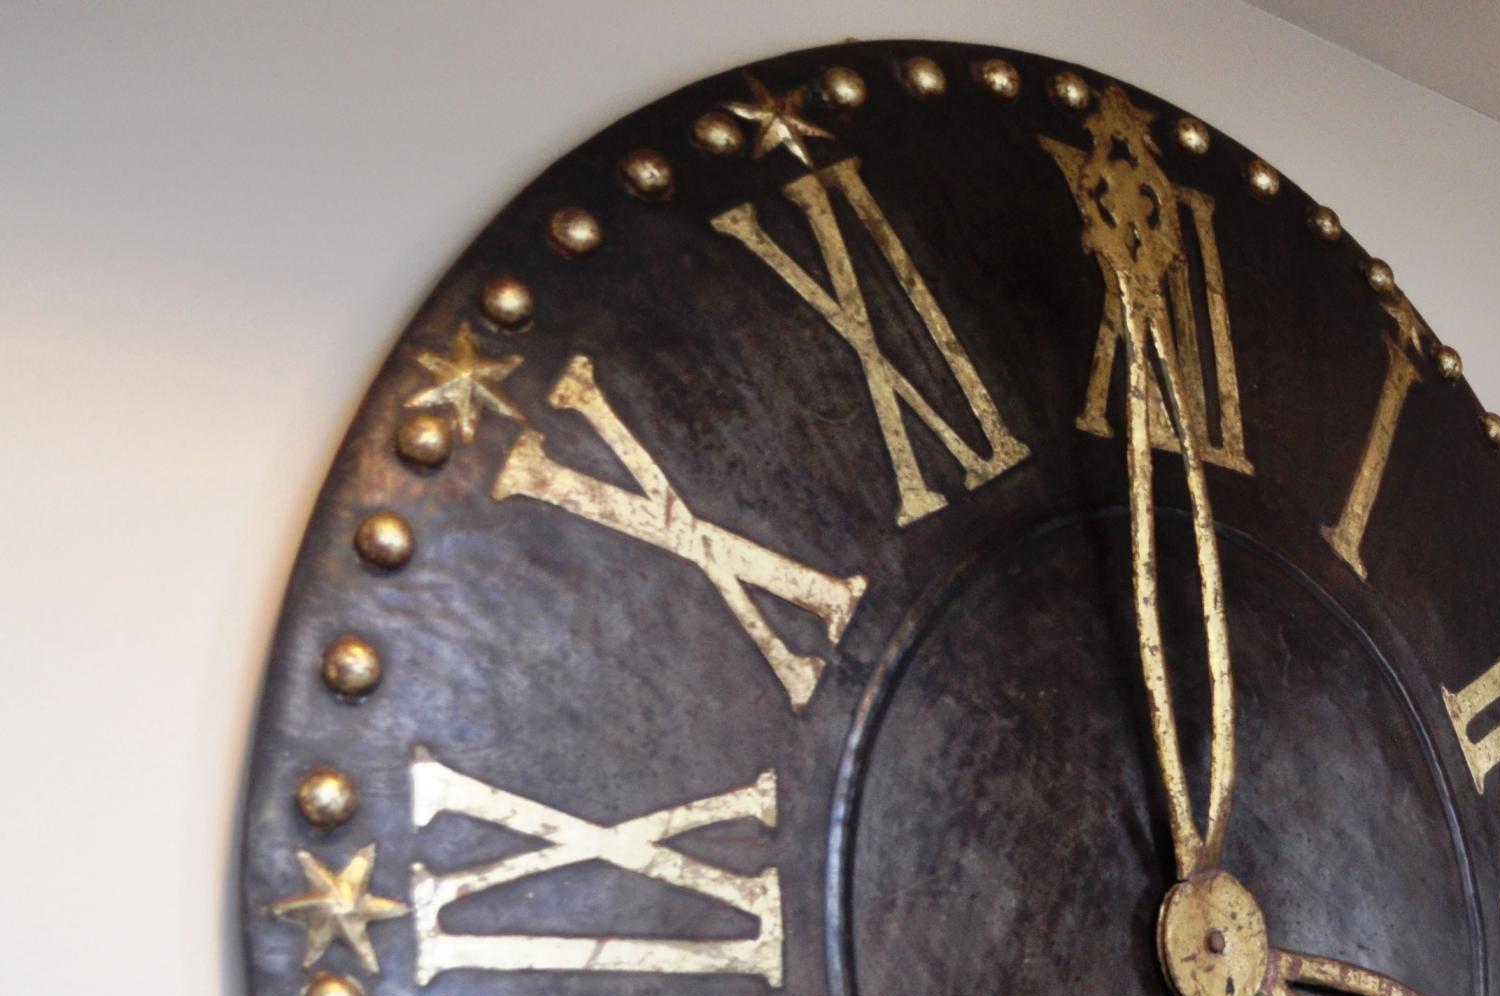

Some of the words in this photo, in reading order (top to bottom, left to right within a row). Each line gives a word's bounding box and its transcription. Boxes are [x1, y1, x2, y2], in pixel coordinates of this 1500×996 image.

[710, 156, 1032, 528] XI
[1319, 329, 1423, 580] I
[491, 353, 868, 713] X
[410, 744, 785, 988] IX
